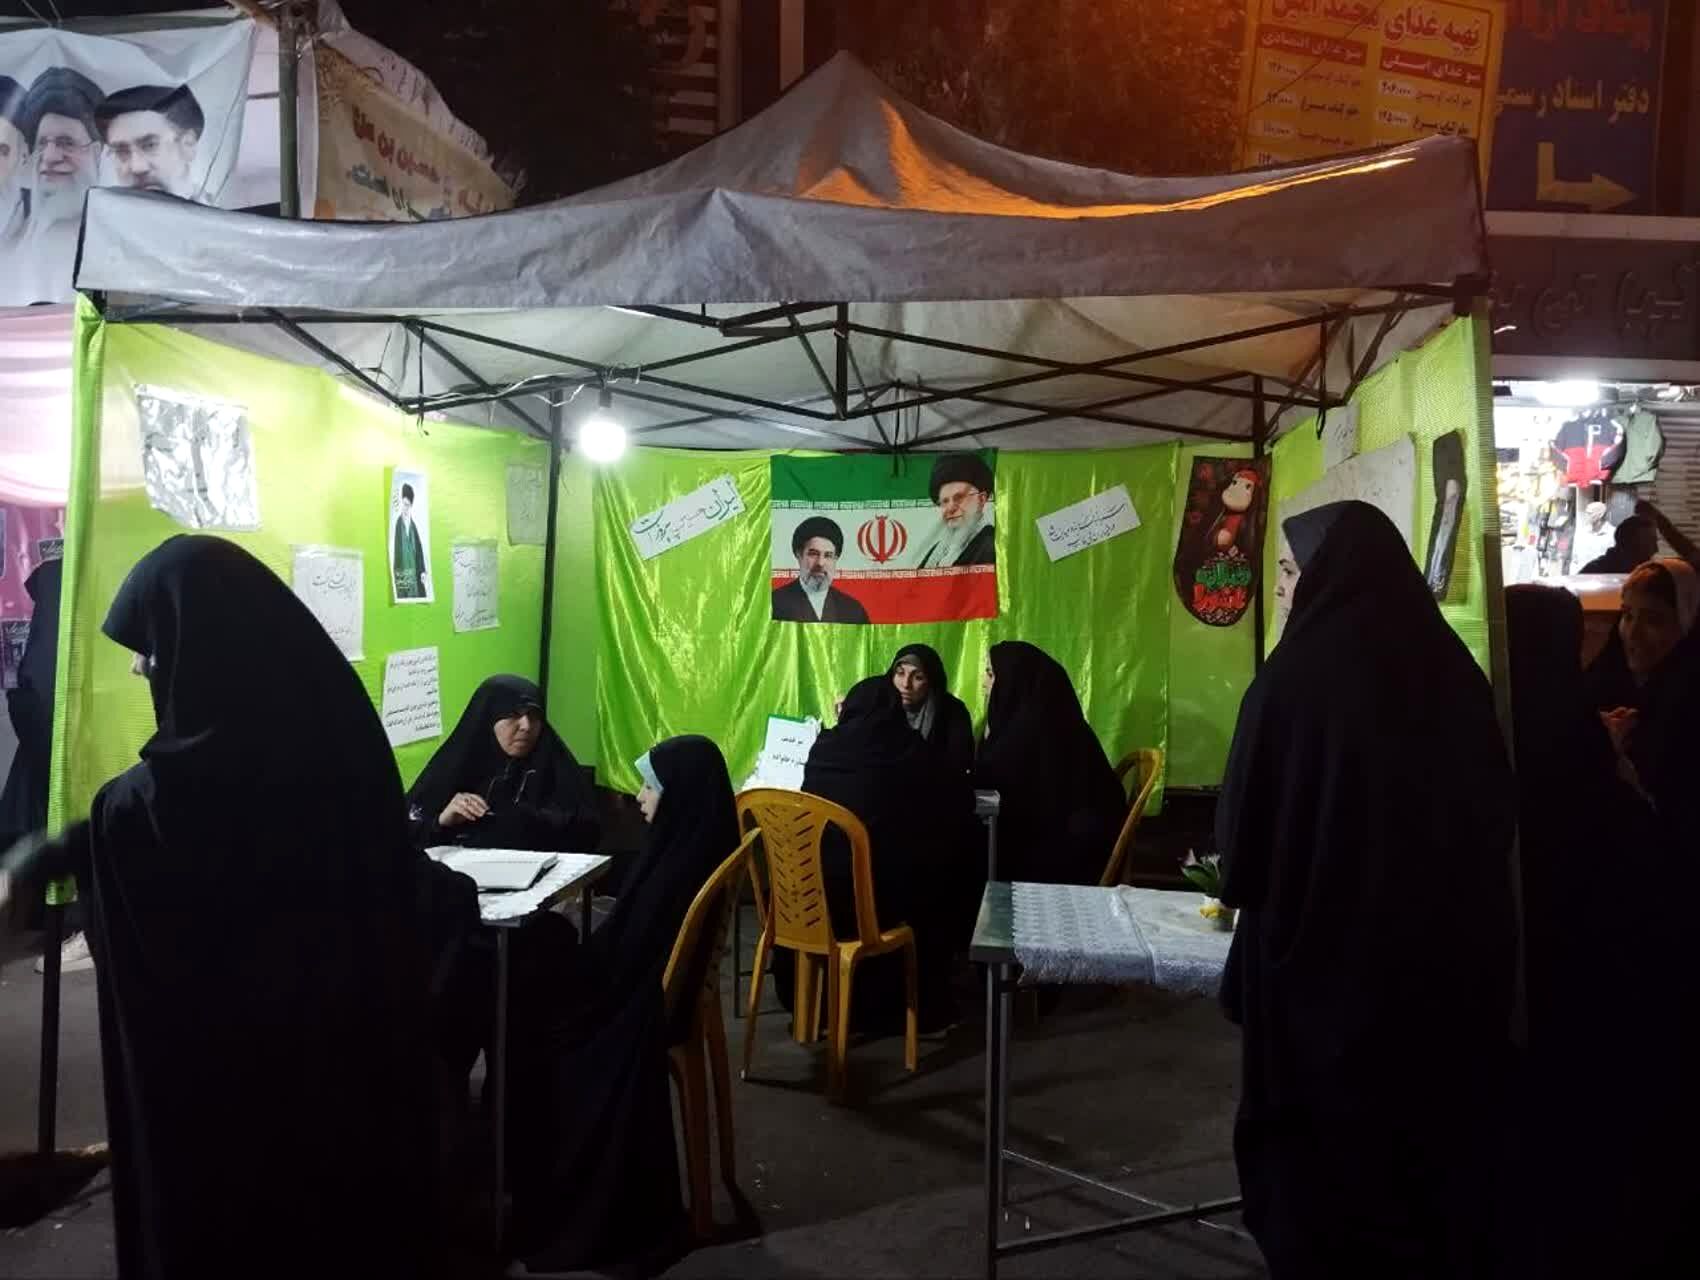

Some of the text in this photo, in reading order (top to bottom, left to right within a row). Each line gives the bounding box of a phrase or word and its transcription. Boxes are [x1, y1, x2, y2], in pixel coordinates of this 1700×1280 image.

[1384, 7, 1442, 42] غذای
[1443, 18, 1482, 48] تهیه
[1552, 76, 1604, 111] اسناد
[1606, 76, 1649, 125] دفتر
[704, 480, 739, 521] ایران
